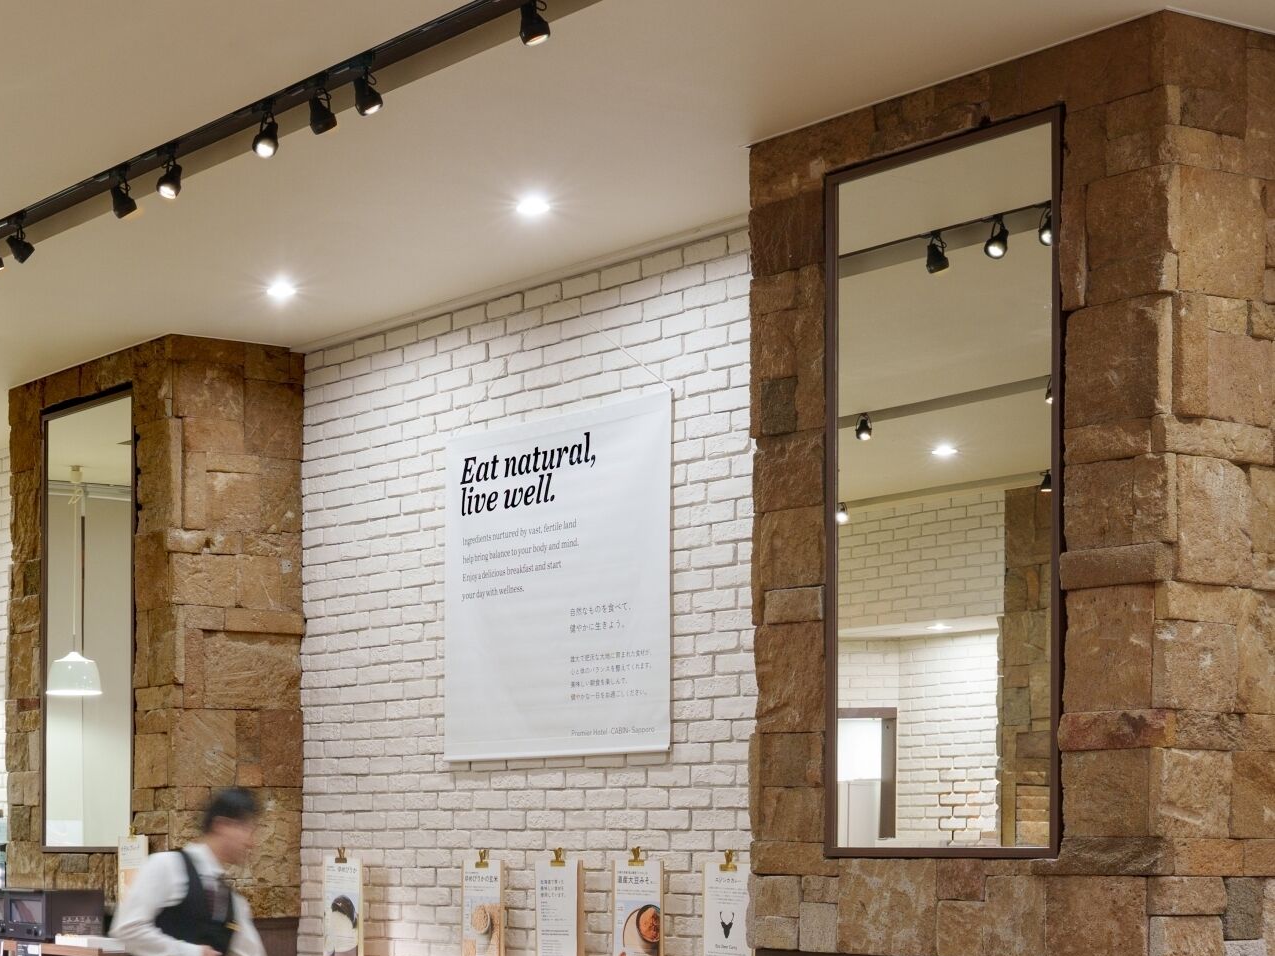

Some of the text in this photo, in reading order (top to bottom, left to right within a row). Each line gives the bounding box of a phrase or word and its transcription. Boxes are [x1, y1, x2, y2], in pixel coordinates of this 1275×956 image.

[460, 432, 596, 485] Eat natural,
[461, 473, 555, 516] live well.
[462, 518, 576, 547] Ingredients nurtured by vast, fertile land
[462, 554, 474, 564] help
[474, 552, 488, 562] bring
[489, 549, 510, 560] balance
[511, 548, 517, 556] to
[517, 546, 532, 557] your
[532, 542, 547, 553] body
[548, 540, 560, 551] and
[462, 572, 478, 582] Enjoy
[481, 569, 505, 579] delicious
[506, 564, 534, 575] breakfast
[534, 561, 546, 571] and
[547, 560, 562, 569] start
[461, 585, 524, 602] your day with wellness.
